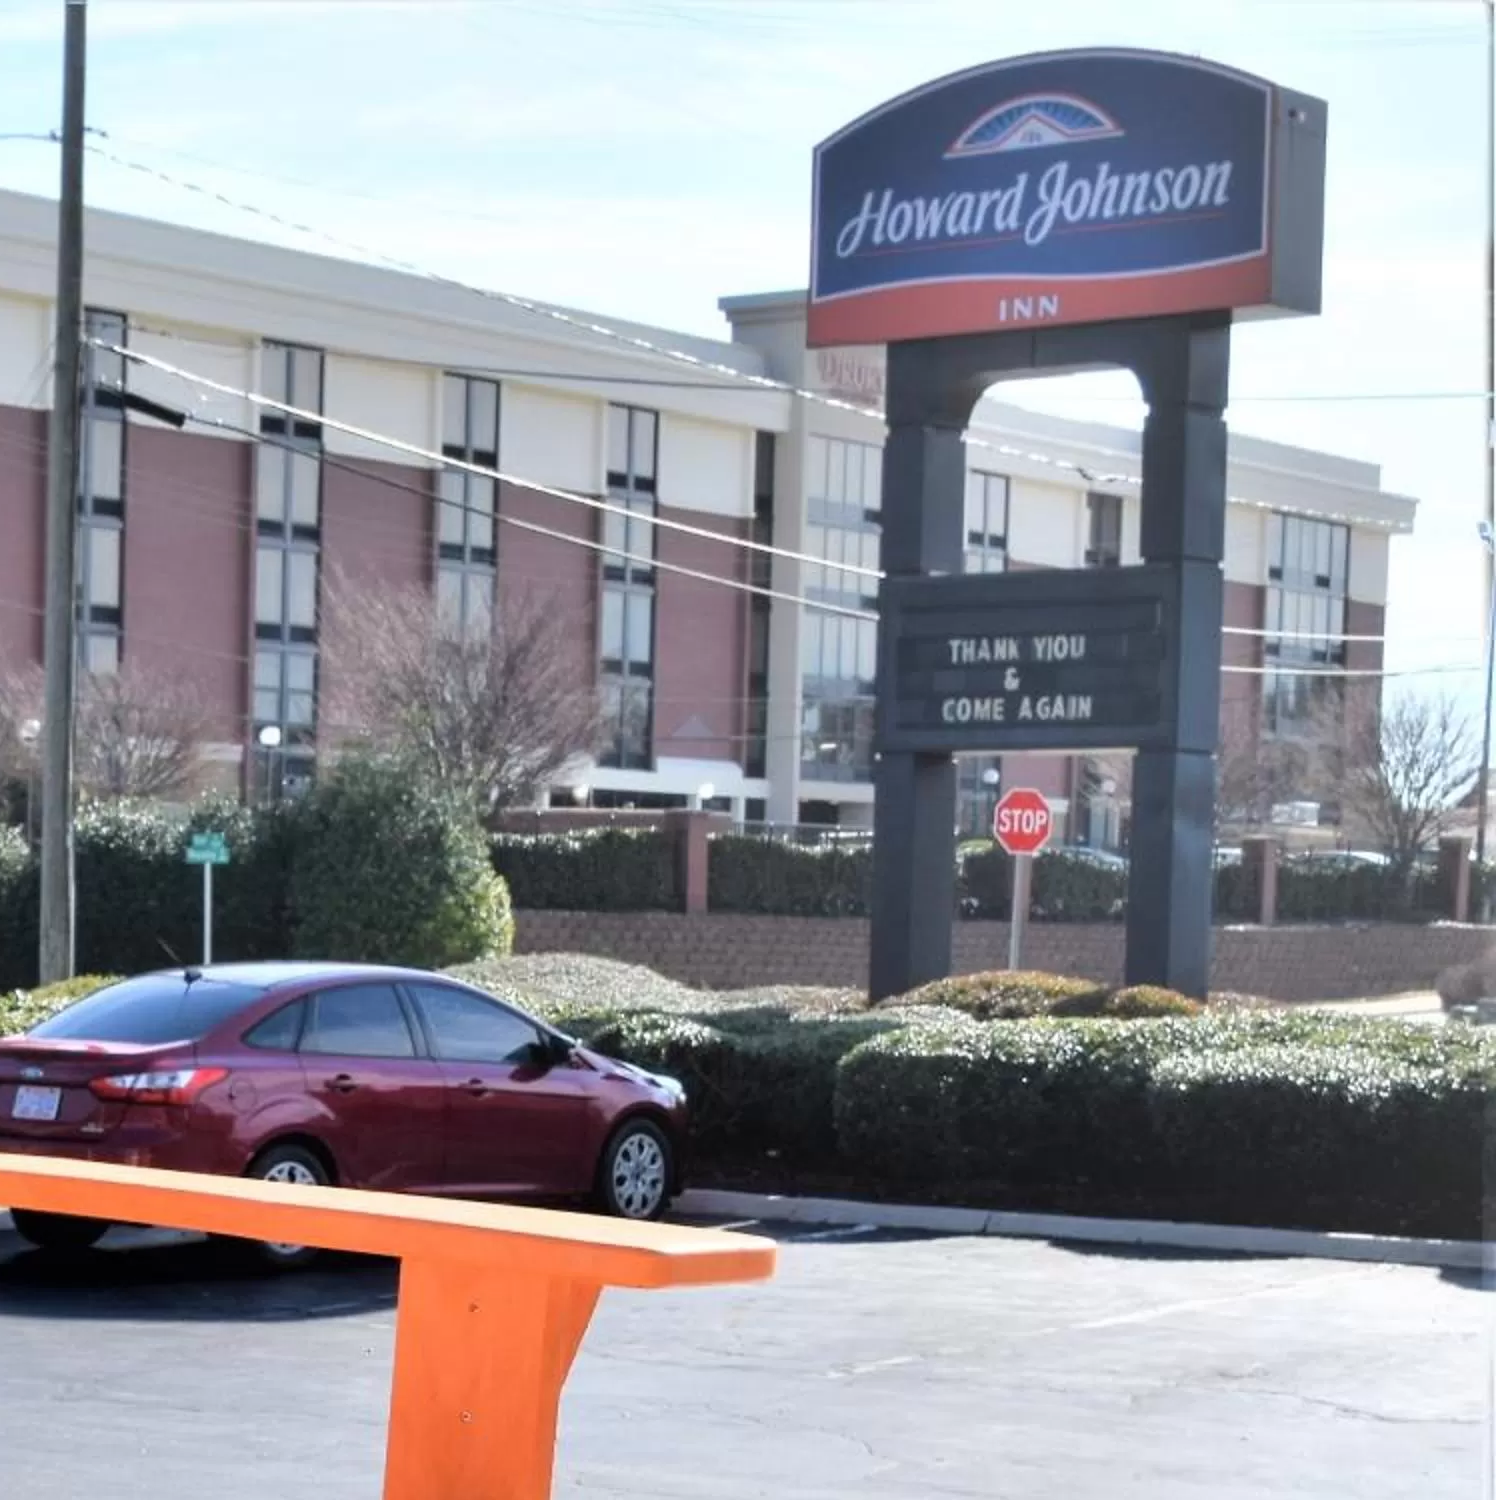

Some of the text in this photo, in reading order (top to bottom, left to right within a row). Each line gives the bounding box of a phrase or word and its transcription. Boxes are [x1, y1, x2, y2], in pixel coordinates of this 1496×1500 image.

[836, 161, 1232, 257] Howard Johnson
[998, 295, 1059, 322] INN
[949, 636, 1020, 664] THANK
[941, 695, 1093, 722] COME AGAIN
[998, 807, 1048, 834] STOP
